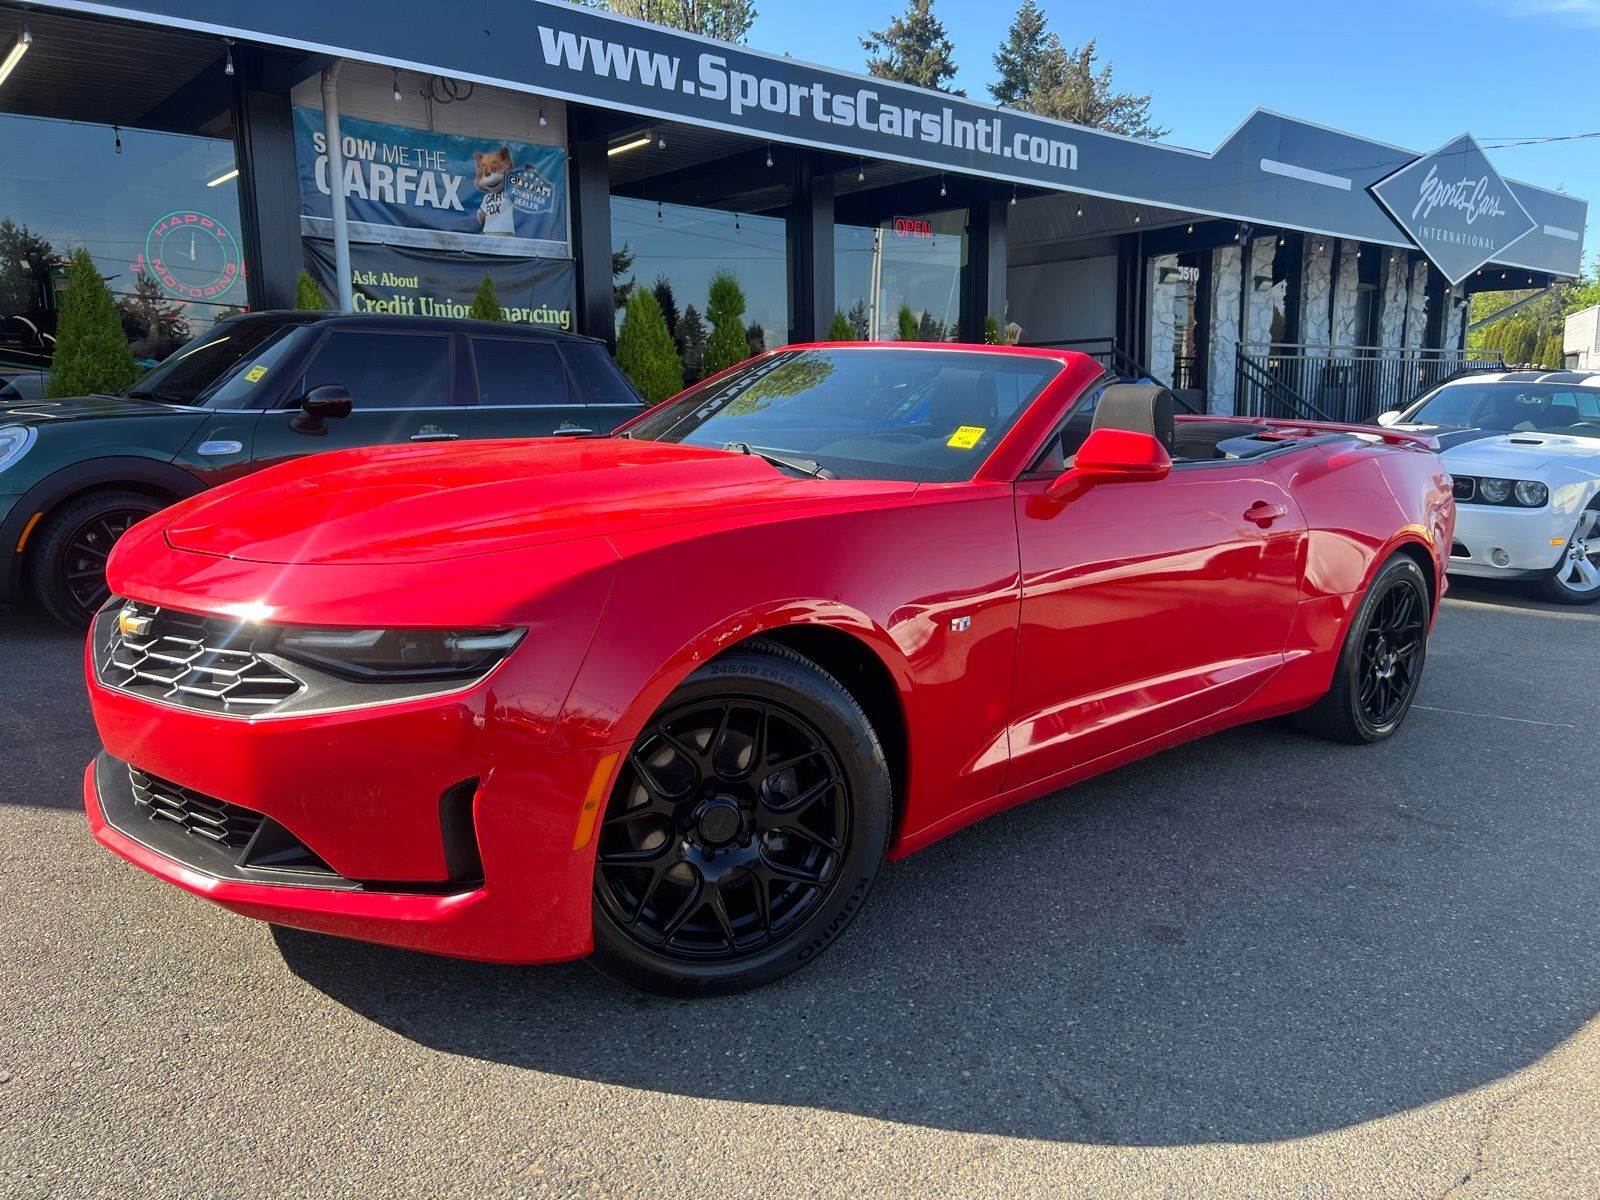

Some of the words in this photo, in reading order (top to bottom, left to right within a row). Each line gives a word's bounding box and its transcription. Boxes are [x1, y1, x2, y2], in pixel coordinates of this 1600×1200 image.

[537, 25, 1078, 171] www.SportsCarsIntl.com
[312, 131, 377, 161] SOW
[383, 143, 410, 167] ME
[413, 148, 447, 172] THE
[509, 176, 552, 198] CARFAX
[511, 187, 547, 206] ADVANTAGE
[486, 203, 501, 215] FOX
[514, 197, 539, 211] DEALER
[1465, 175, 1505, 224] Cars
[155, 214, 227, 237] HAPPY
[895, 219, 931, 239] OPEN
[1419, 225, 1496, 250] INTERNATIONAL
[152, 258, 237, 298] MOTORING
[352, 270, 378, 286] Ask
[380, 272, 419, 289] About
[352, 292, 415, 316] Credit
[797, 876, 870, 961] KUMHO
